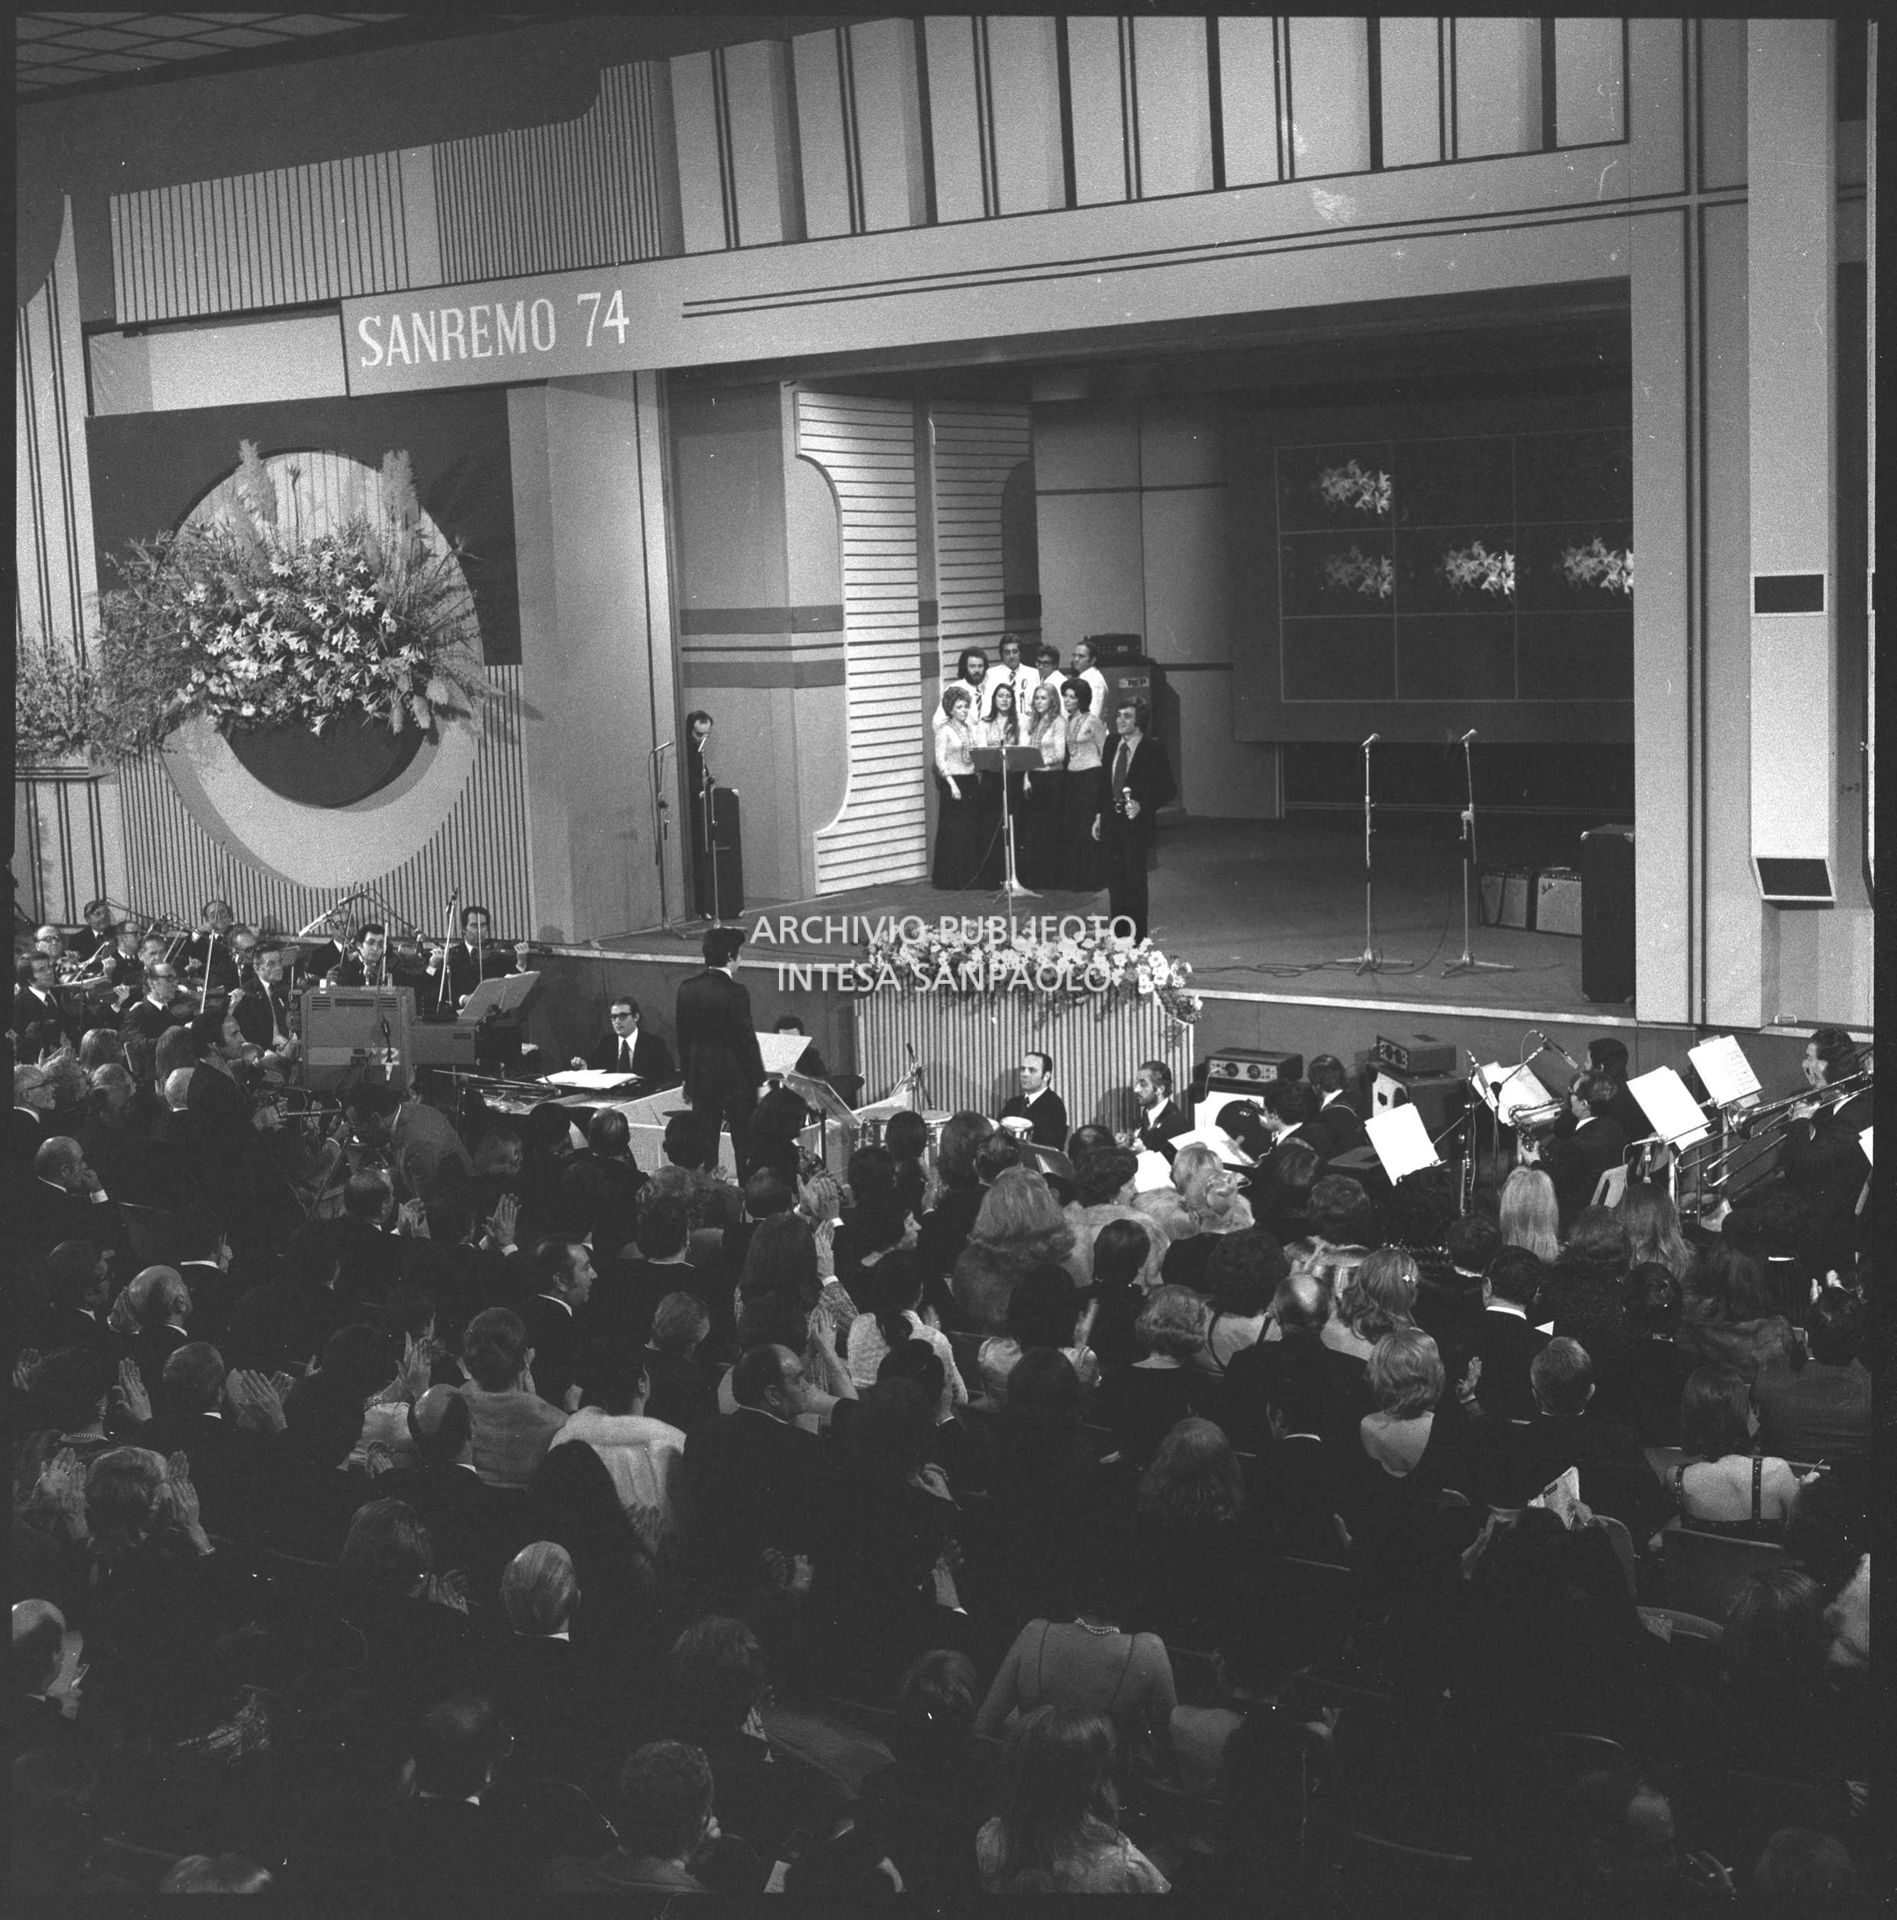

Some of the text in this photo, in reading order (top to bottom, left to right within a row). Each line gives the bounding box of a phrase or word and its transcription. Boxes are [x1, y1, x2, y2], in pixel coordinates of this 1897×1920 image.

[357, 289, 630, 368] SANREMO 74
[381, 1047, 400, 1065] 2
